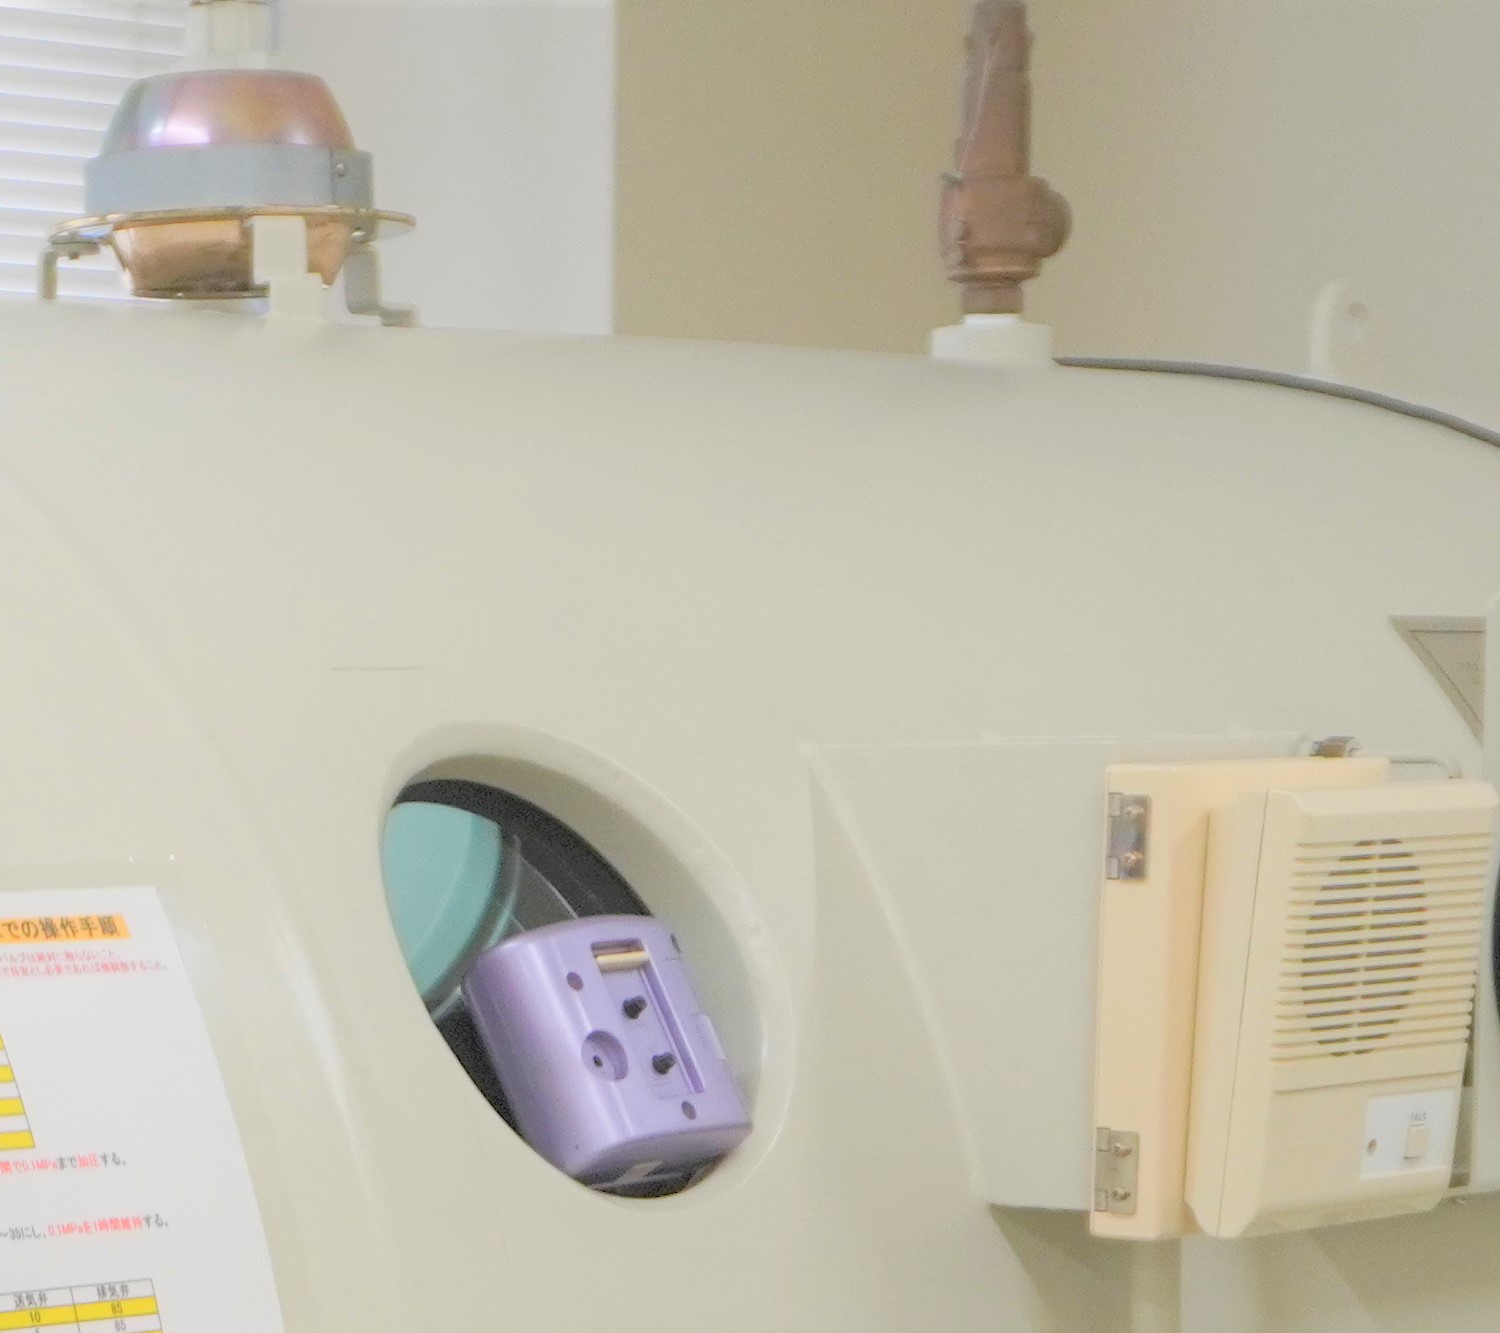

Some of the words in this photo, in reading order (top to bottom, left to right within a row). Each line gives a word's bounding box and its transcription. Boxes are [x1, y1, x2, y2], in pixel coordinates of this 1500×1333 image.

[97, 1281, 130, 1299] 排気弁
[14, 1291, 49, 1308] 送気弁
[29, 1311, 41, 1323] 10
